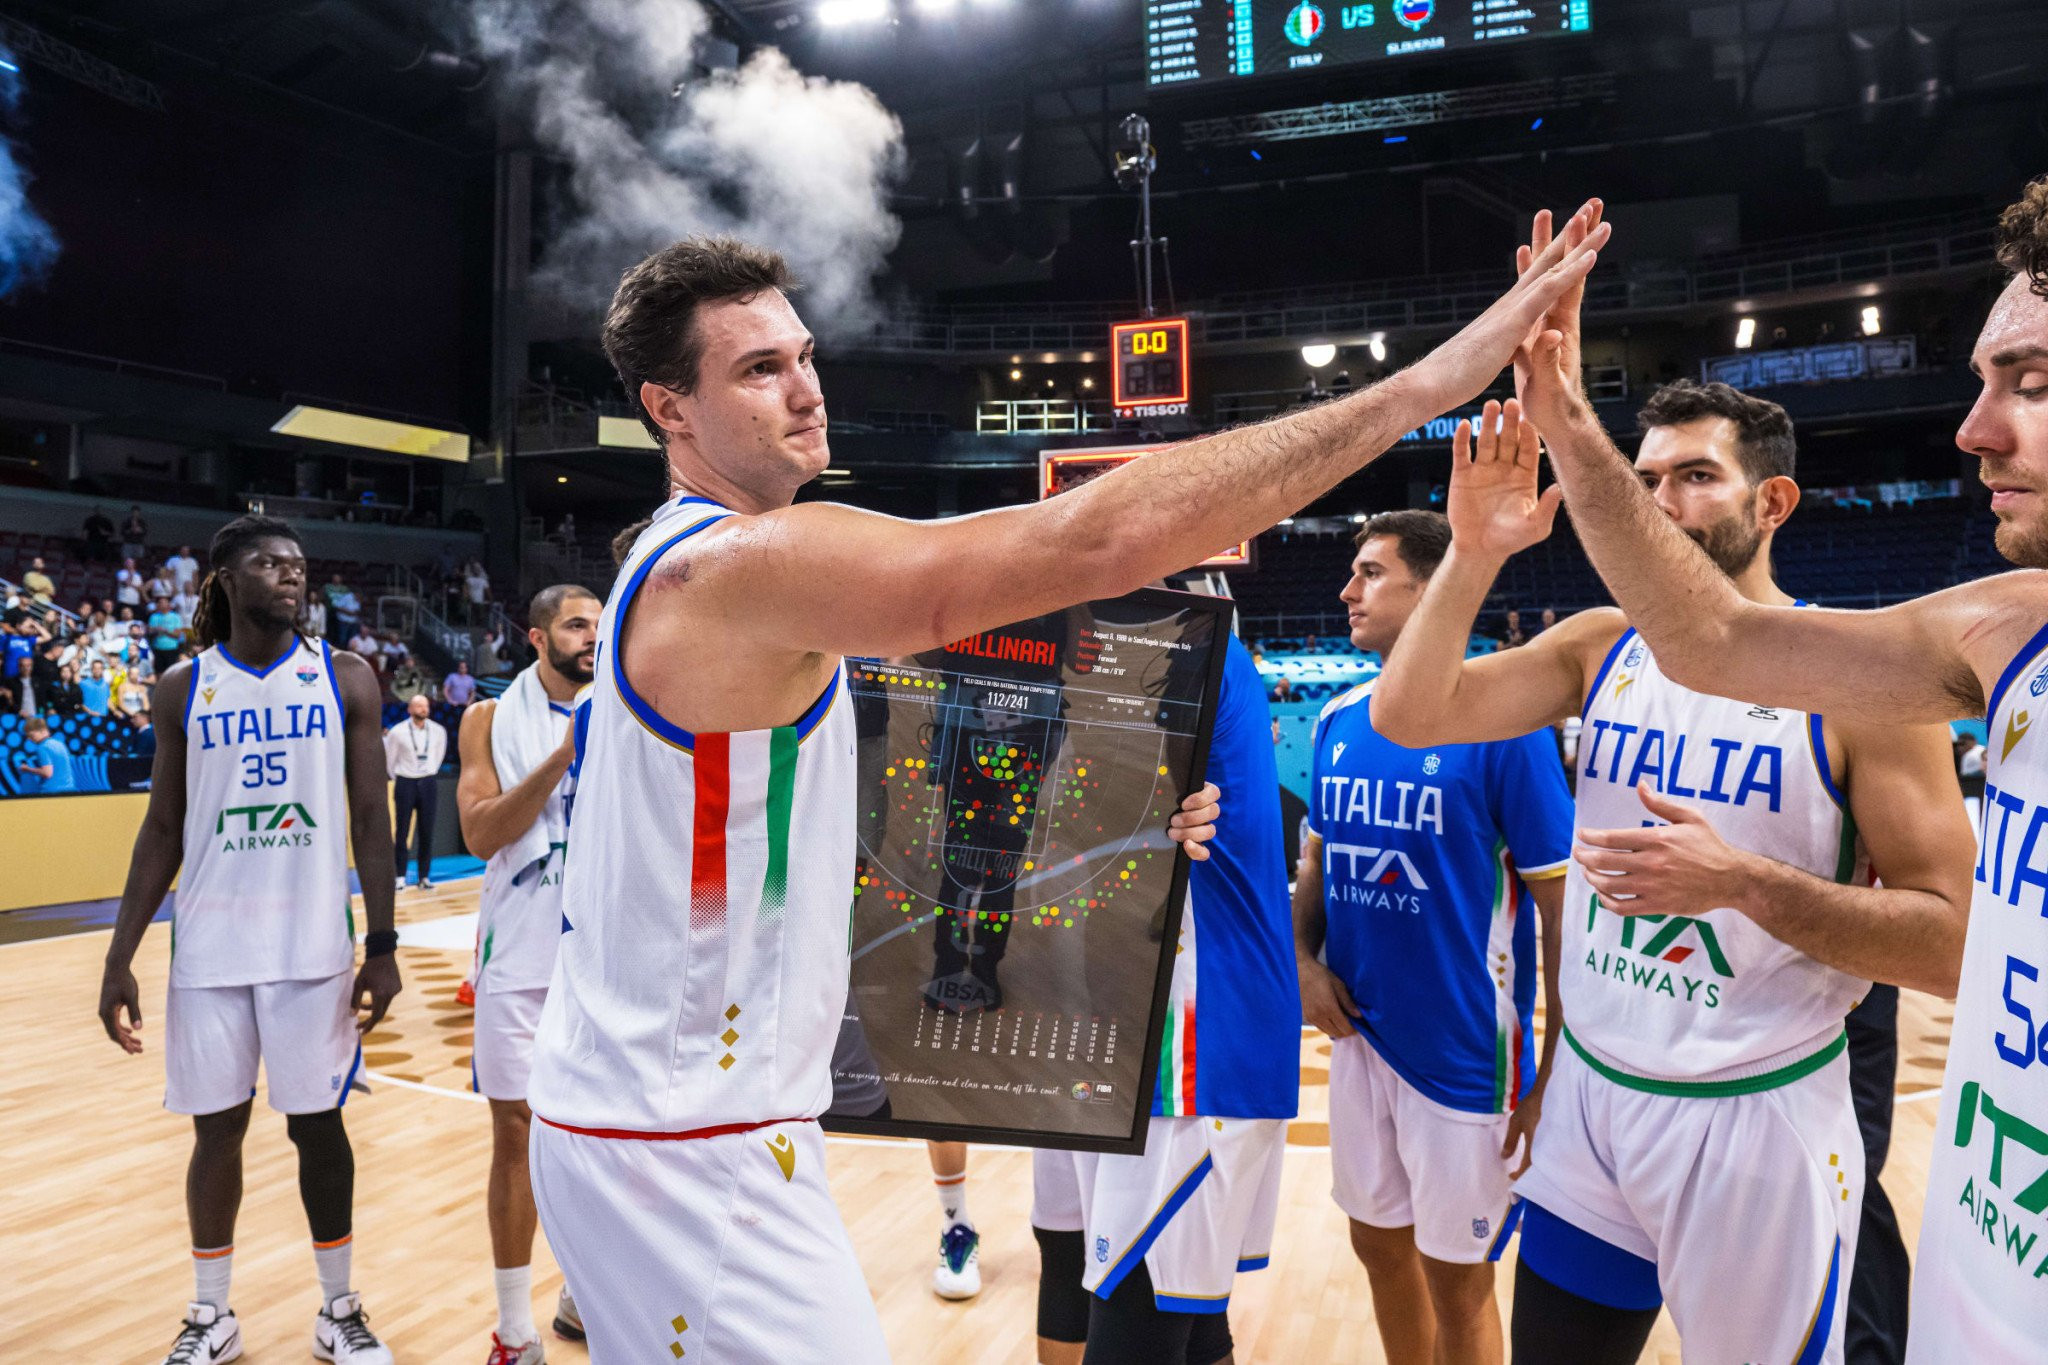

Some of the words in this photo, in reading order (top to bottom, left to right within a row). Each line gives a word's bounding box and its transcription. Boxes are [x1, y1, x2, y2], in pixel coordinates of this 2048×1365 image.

[1341, 4, 1375, 30] VS
[1132, 330, 1167, 355] 0.0
[1134, 403, 1188, 418] TISSOT
[1098, 654, 1117, 664] Forward
[988, 692, 1029, 710] 112/241
[196, 704, 326, 750] ITALIA
[241, 751, 287, 789] 35
[1585, 719, 1782, 813] ITALIA
[216, 802, 318, 835] ITA
[1321, 776, 1443, 835] ITALIA
[223, 833, 312, 852] AIRWAYS
[1326, 842, 1429, 891] ITA
[1329, 883, 1420, 914] AIRWAYS
[937, 980, 987, 1002] IBSA
[1585, 948, 1719, 1008] AIRWAYS
[848, 1071, 880, 1085] inspiring
[884, 1072, 900, 1082] with
[903, 1073, 939, 1085] character
[942, 1077, 958, 1087] and
[961, 1077, 978, 1089] class
[994, 1081, 1009, 1092] and
[1013, 1083, 1022, 1095] off
[1025, 1083, 1037, 1093] the
[1096, 1084, 1112, 1093] FIBA
